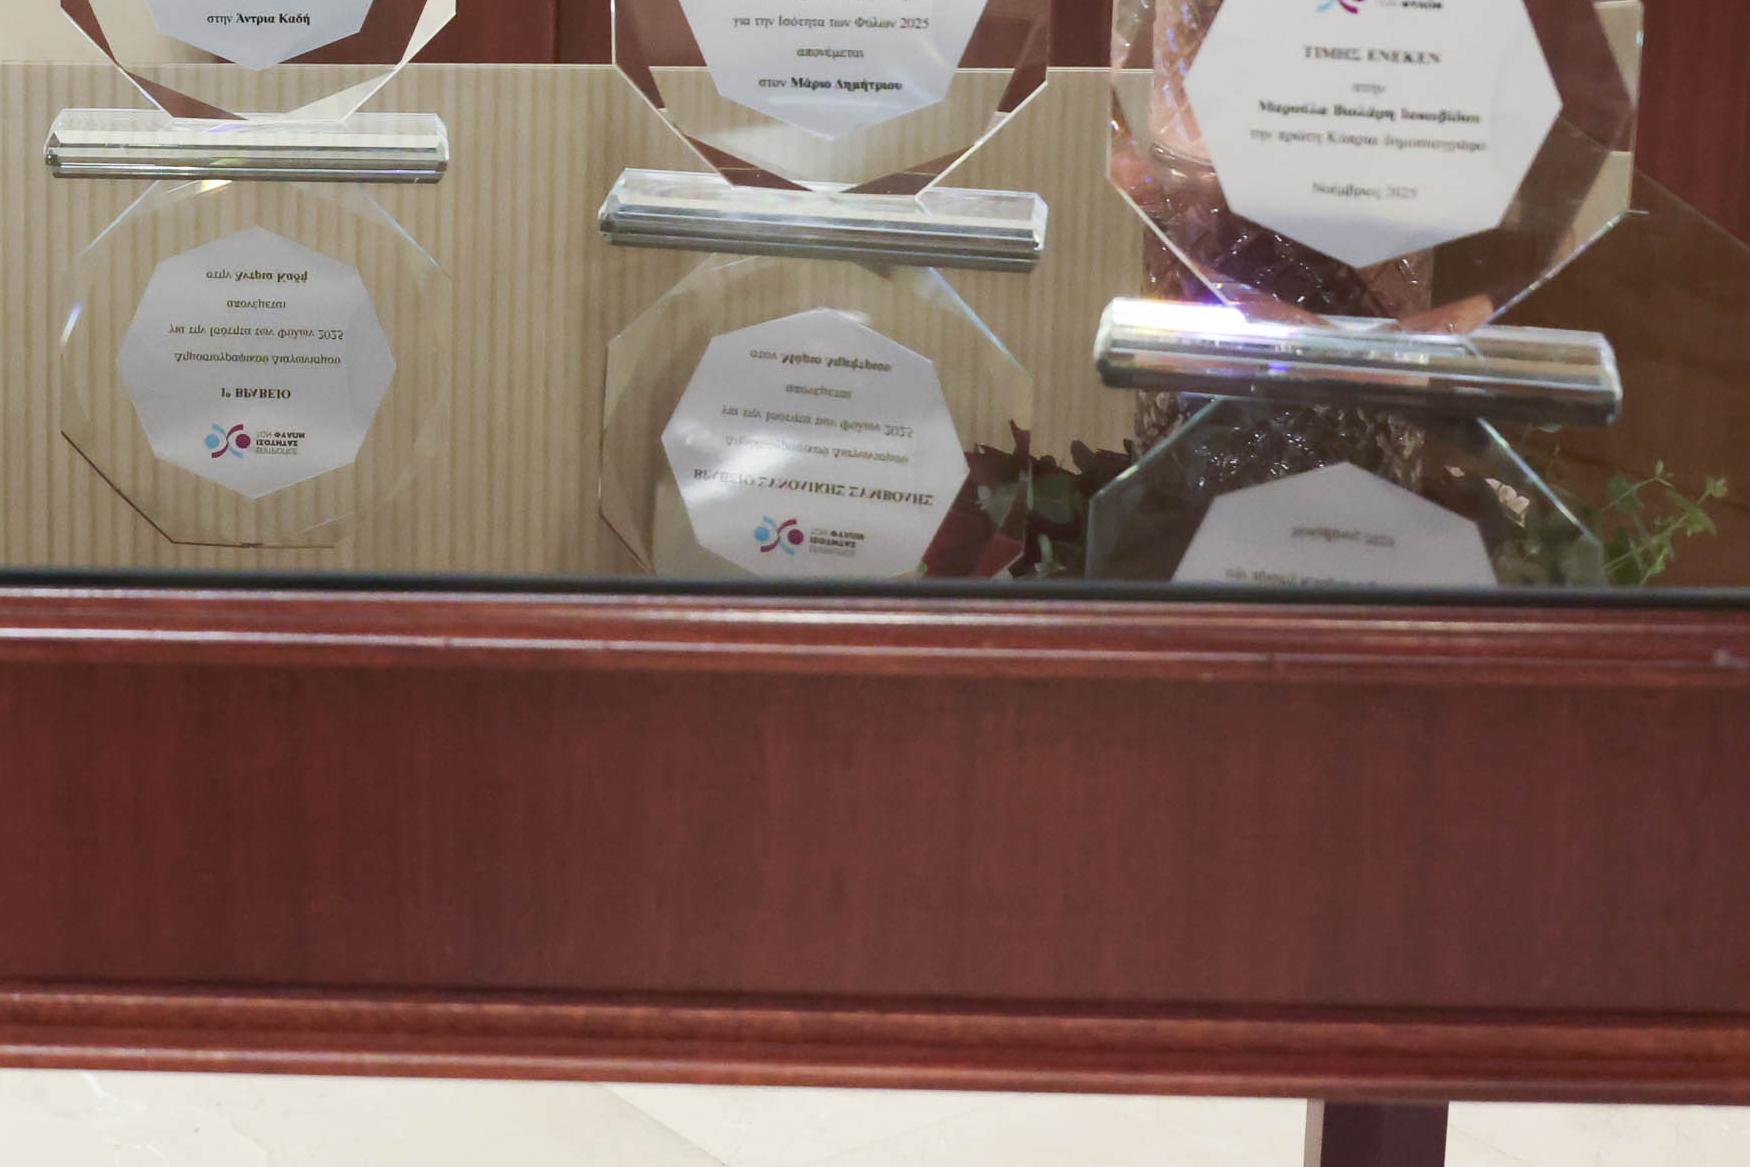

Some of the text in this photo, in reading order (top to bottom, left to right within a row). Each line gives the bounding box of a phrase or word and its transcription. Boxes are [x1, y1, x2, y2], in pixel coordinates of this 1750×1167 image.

[206, 12, 311, 26] στην Άντρια Καδή
